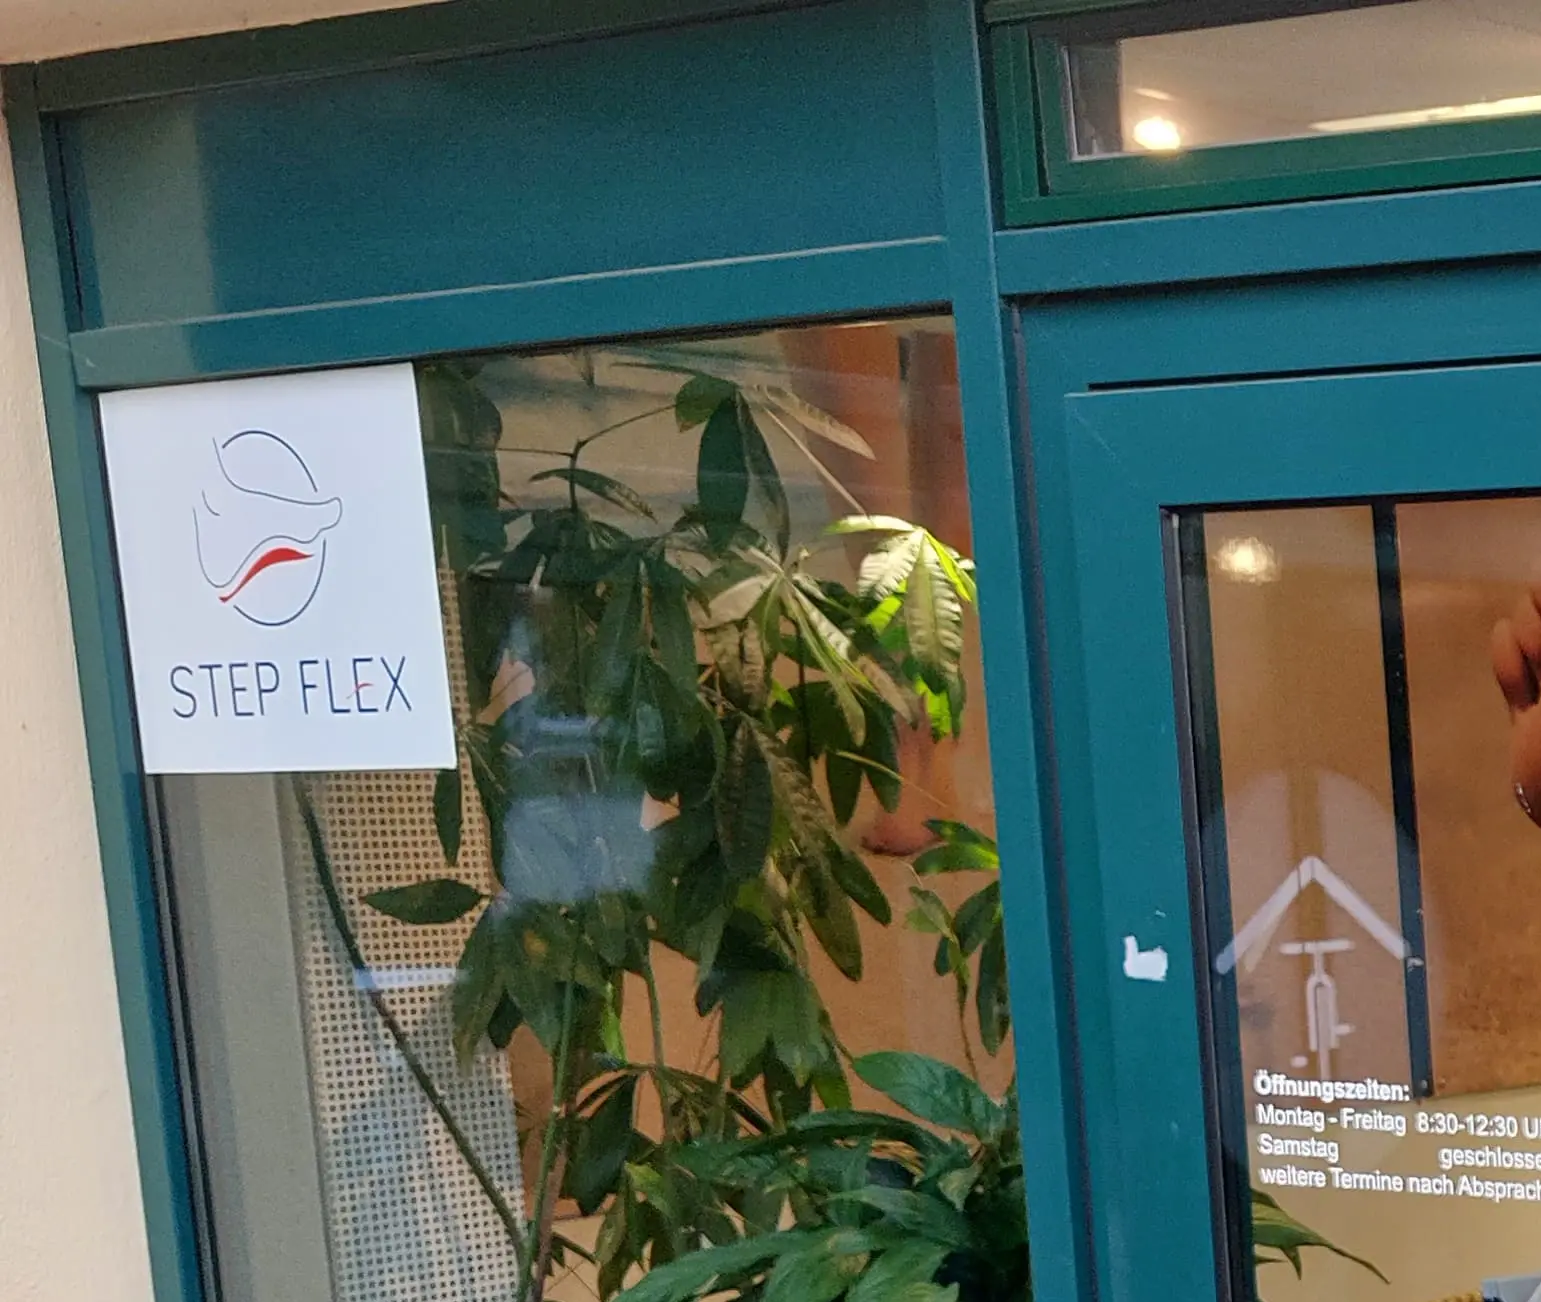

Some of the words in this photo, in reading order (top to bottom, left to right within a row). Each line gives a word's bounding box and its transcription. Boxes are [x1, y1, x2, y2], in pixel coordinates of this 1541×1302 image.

[169, 661, 280, 719] STEP
[299, 655, 413, 715] FLEX
[1253, 1069, 1410, 1103] Öffnungszeiten:
[1255, 1104, 1326, 1131] Montag
[1340, 1107, 1407, 1137] Freitag
[1414, 1111, 1518, 1139] 8:30-12:30
[1257, 1132, 1339, 1164] Samstag
[1259, 1164, 1327, 1188] weitere
[1329, 1166, 1404, 1192] Termine
[1408, 1174, 1454, 1196] nach
